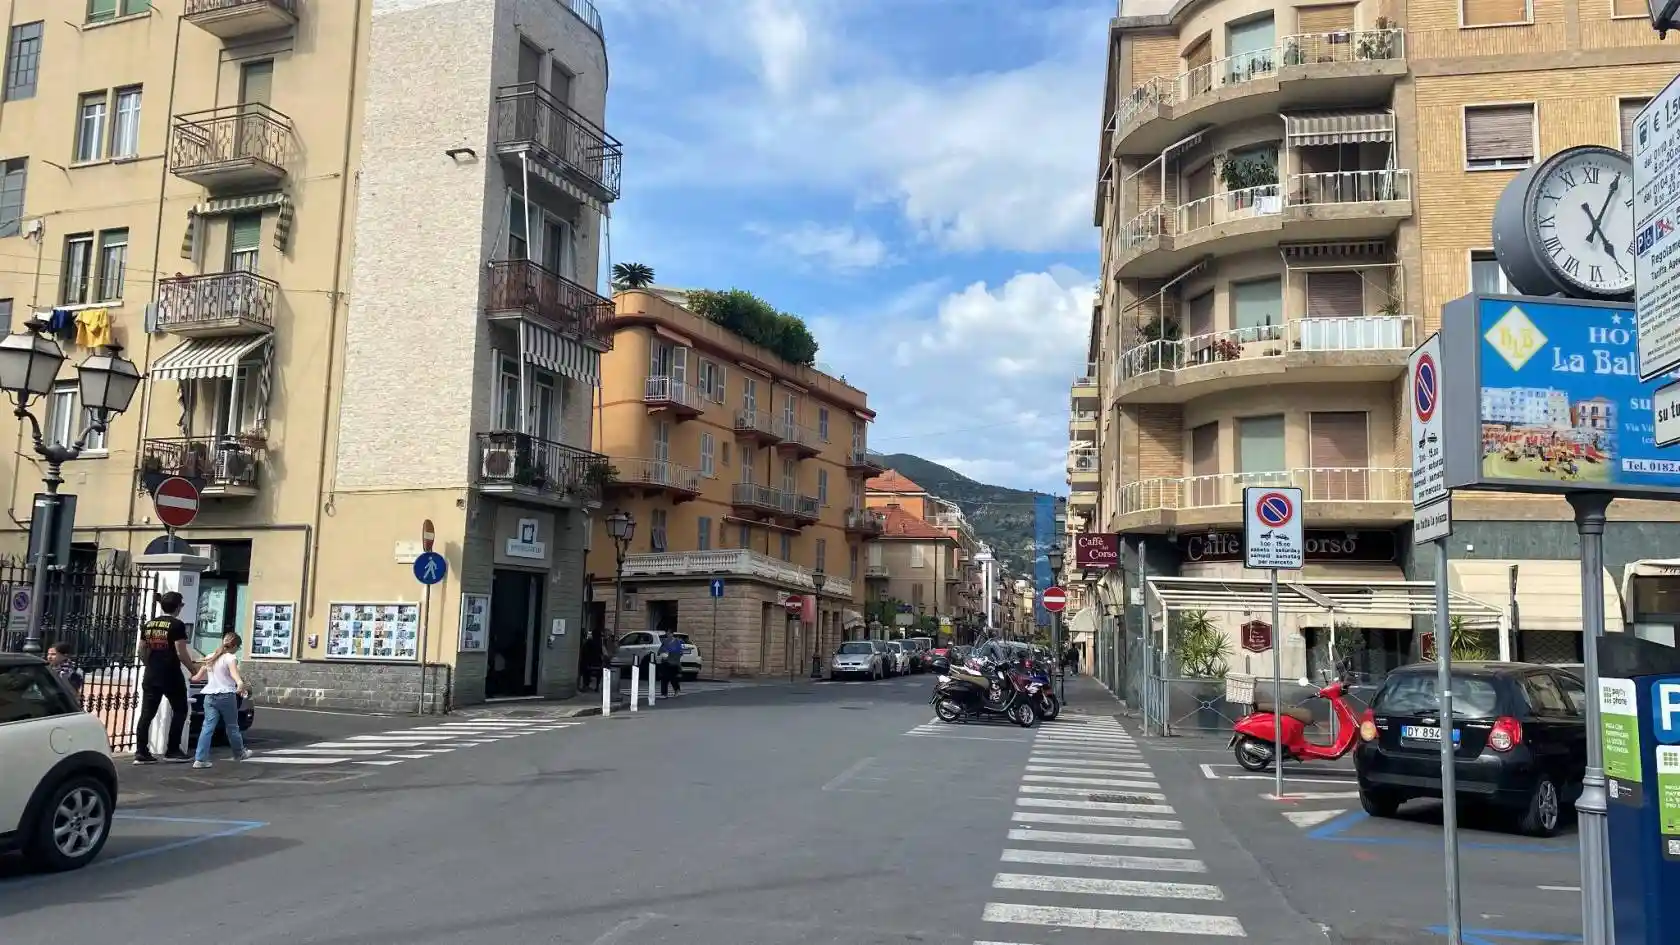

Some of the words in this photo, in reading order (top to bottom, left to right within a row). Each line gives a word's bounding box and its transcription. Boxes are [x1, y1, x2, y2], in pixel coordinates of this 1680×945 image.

[1654, 110, 1660, 132] €
[1559, 170, 1577, 192] XI
[1583, 167, 1600, 184] XII
[1543, 188, 1562, 207] X
[1539, 214, 1556, 228] IX
[1542, 235, 1565, 259] VIII
[1562, 254, 1580, 277] VII
[1589, 264, 1603, 282] VI
[1552, 347, 1585, 373] La
[1592, 349, 1637, 376] Bal
[1658, 407, 1668, 422] su
[1626, 460, 1646, 471] Tel.
[1079, 537, 1104, 547] Caffè
[1188, 533, 1240, 560] Caffè
[1305, 538, 1356, 553] orso
[1089, 550, 1117, 559] Corso
[1408, 727, 1419, 737] DY
